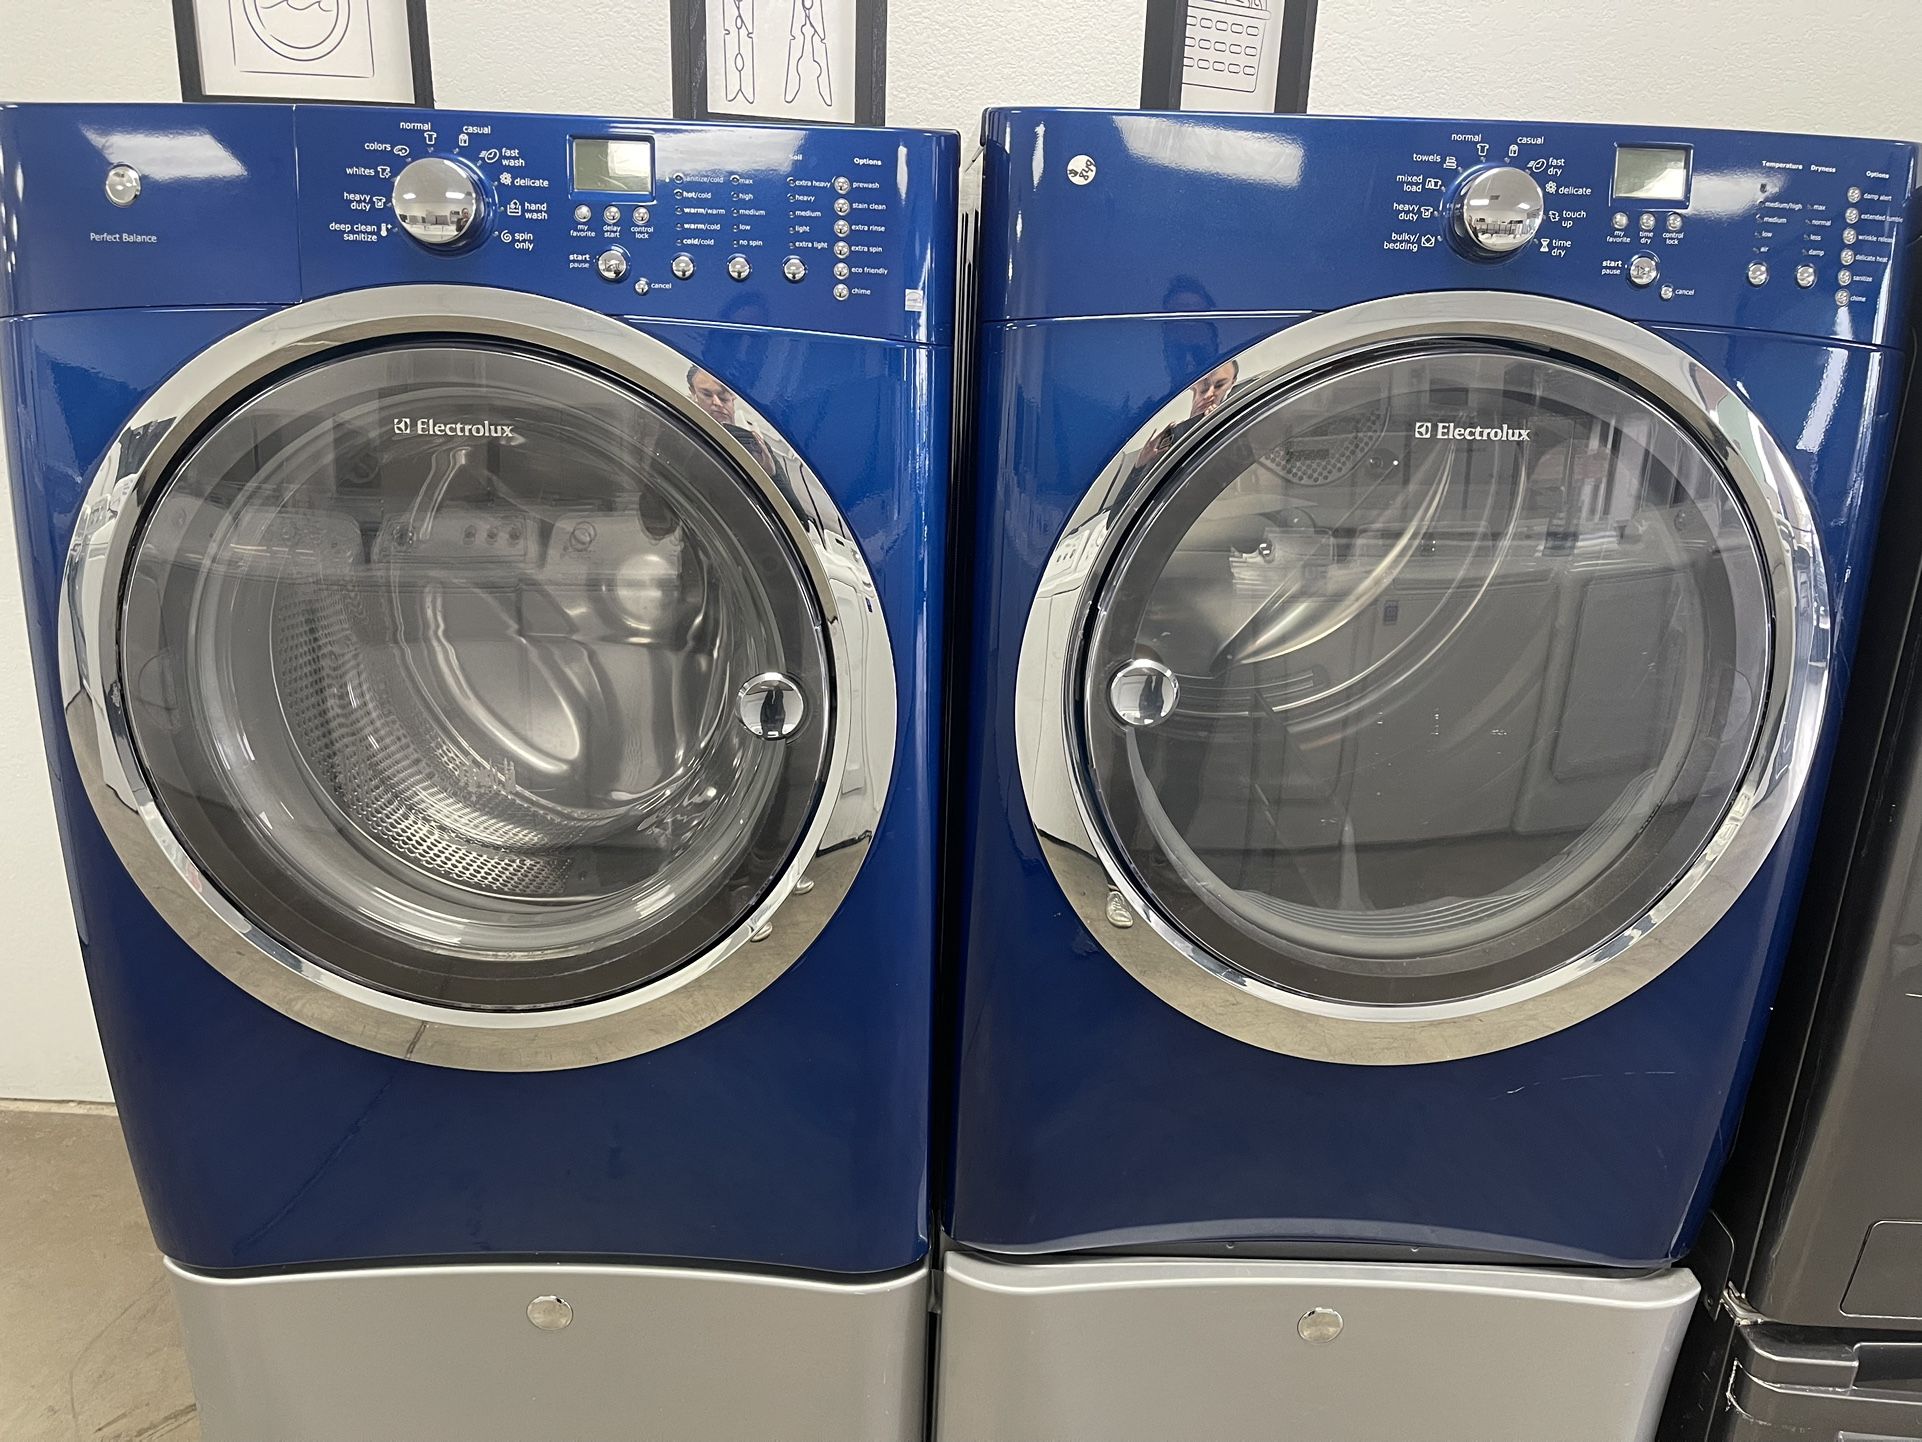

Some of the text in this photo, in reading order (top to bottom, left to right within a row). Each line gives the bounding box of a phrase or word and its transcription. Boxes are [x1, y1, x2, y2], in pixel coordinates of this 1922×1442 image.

[400, 122, 431, 130] normal
[463, 126, 491, 134] casual
[1452, 134, 1481, 142] normal
[1517, 136, 1544, 144] casual
[364, 142, 391, 150] colors
[502, 148, 519, 157] fast
[854, 158, 882, 166] Options
[1413, 153, 1441, 162] towels
[1549, 157, 1565, 166] fast
[502, 158, 525, 167] wash
[1762, 161, 1836, 173] Temperature Dryness
[346, 167, 375, 176] whites
[1079, 159, 1096, 180] 849
[1548, 167, 1562, 176] dry
[1866, 170, 1889, 178] Options
[514, 178, 548, 187] delicate
[1396, 174, 1423, 182] mixed
[812, 180, 831, 188] heavy
[1404, 184, 1422, 192] load
[683, 191, 712, 199] hot/cold
[1559, 186, 1592, 195] delicate
[344, 192, 370, 202] heavy
[739, 193, 753, 201] high
[351, 202, 371, 211] duty
[525, 202, 546, 211] hand
[1393, 202, 1419, 212] heavy
[1765, 202, 1802, 210] medium/high
[525, 211, 548, 219] wash
[1398, 212, 1418, 221] duty
[1562, 210, 1586, 218] touch
[329, 222, 377, 232] deep clean
[1562, 220, 1572, 228] up
[795, 225, 810, 233] light
[90, 233, 157, 242] Perfect Balance
[344, 233, 378, 241] sanitize
[515, 232, 533, 241] spin
[1391, 232, 1419, 242] bulky/
[515, 241, 533, 251] only
[683, 238, 714, 246] cold/cold
[1384, 241, 1418, 252] bedding
[1552, 239, 1571, 247] time
[1551, 248, 1566, 258] dry
[864, 267, 888, 275] friendly
[417, 418, 514, 437] Electrolux
[1436, 422, 1531, 441] Electrolux
